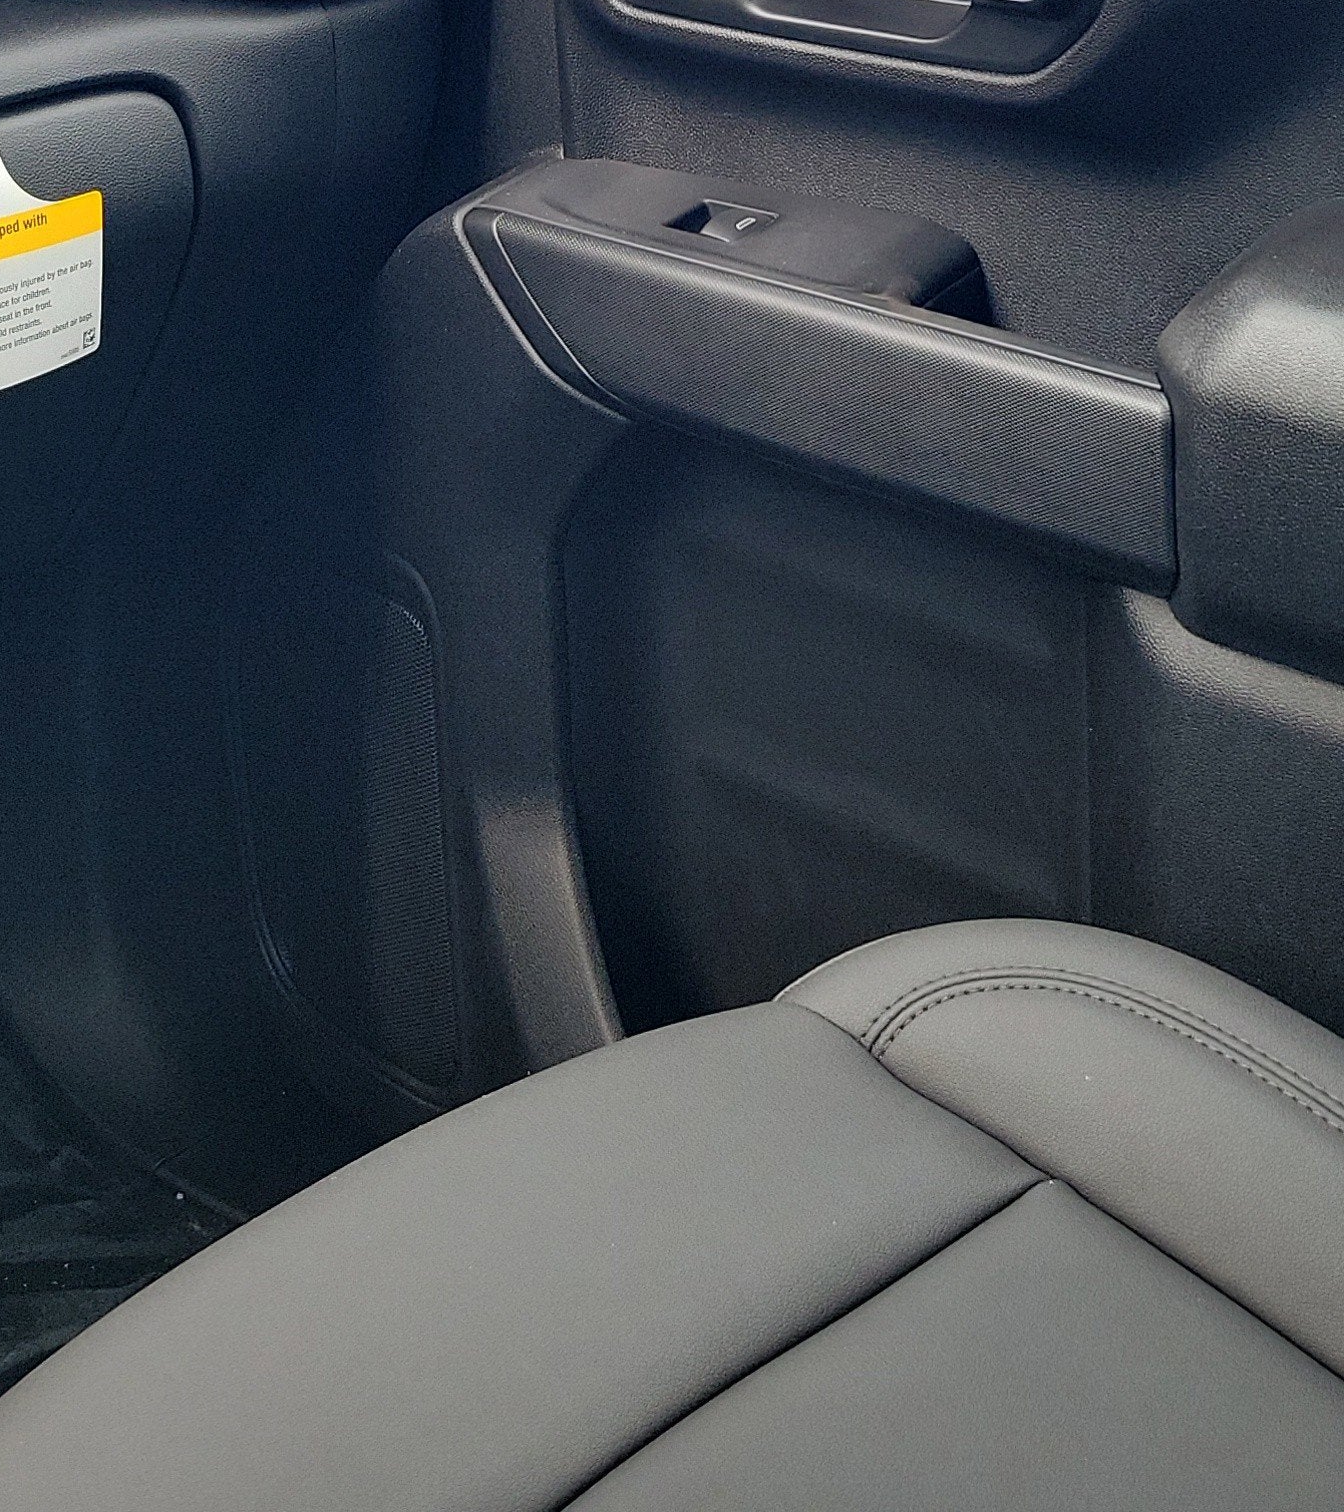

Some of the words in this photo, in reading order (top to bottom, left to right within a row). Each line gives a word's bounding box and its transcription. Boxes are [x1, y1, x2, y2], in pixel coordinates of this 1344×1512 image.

[22, 213, 48, 230] with
[20, 275, 46, 288] injured
[46, 271, 55, 281] by
[57, 267, 68, 277] the
[69, 263, 79, 272] air
[11, 296, 21, 306] for
[15, 310, 22, 318] in
[23, 306, 34, 316] the
[14, 329, 51, 347] information
[52, 322, 69, 334] about
[69, 318, 78, 326] air
